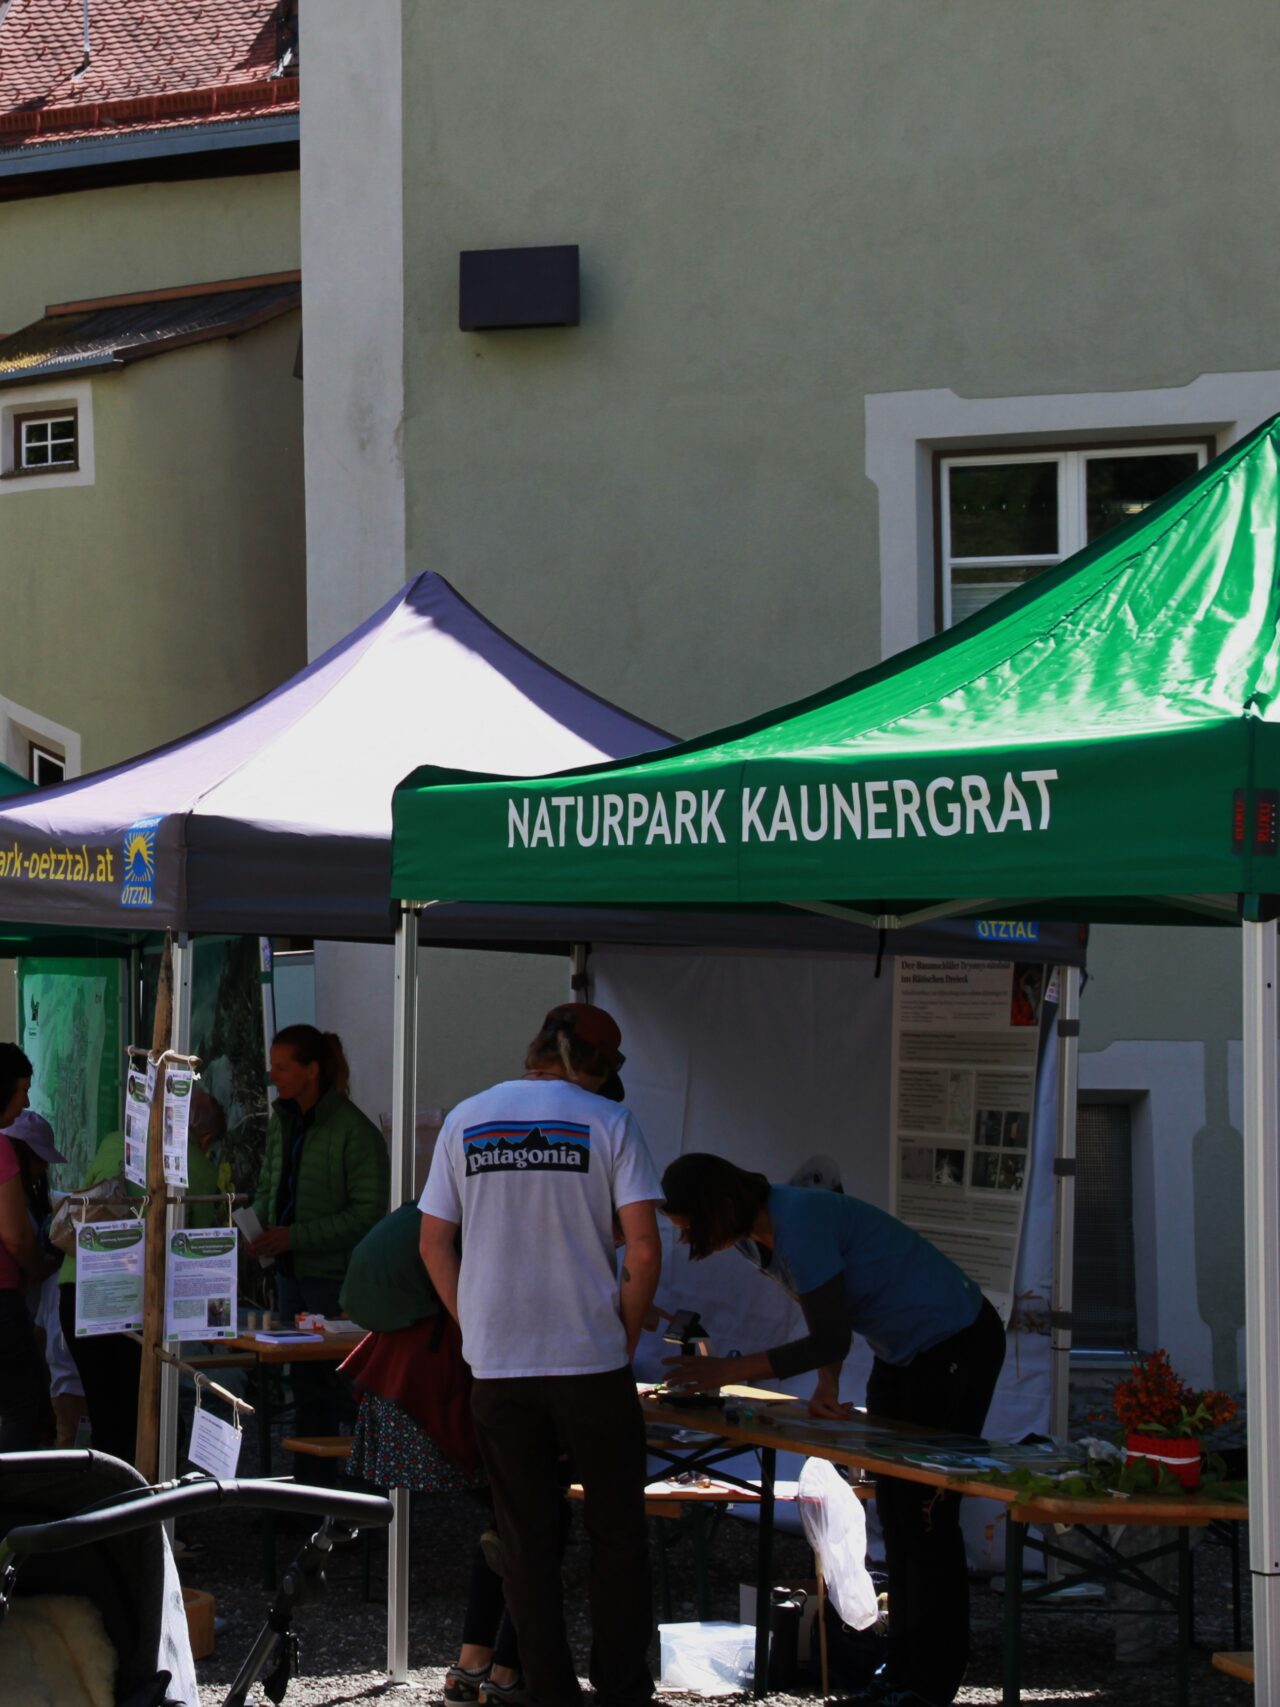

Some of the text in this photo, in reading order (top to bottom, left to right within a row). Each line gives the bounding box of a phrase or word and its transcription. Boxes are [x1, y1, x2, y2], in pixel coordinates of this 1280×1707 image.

[507, 769, 1059, 848] NATURPARK KAUNERGRAT
[468, 1146, 582, 1173] patagonia
